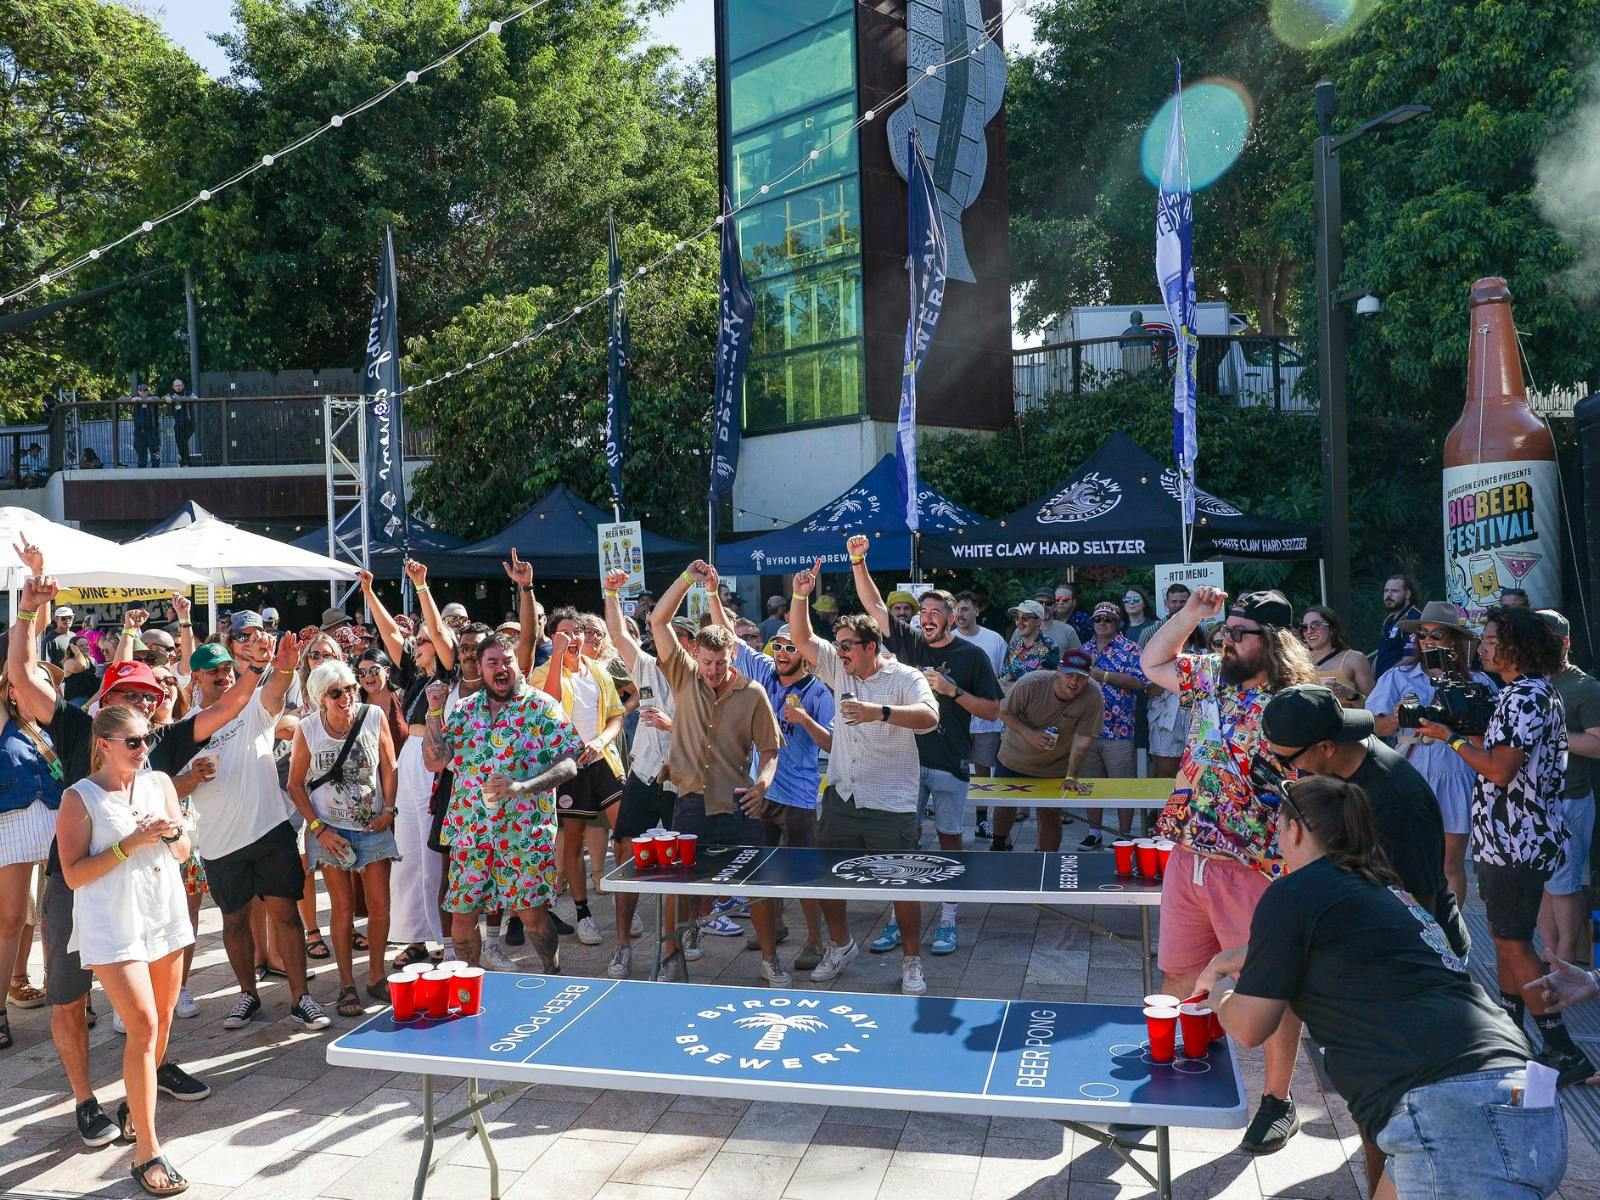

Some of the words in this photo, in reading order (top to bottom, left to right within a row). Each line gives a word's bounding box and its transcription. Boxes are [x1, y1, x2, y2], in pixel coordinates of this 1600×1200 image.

[1498, 467, 1532, 482] PRESENTS
[1448, 494, 1475, 529] BIG
[1475, 481, 1533, 520] BEER
[1447, 510, 1536, 554] FESTIVAL
[766, 556, 797, 566] BYRON
[799, 555, 817, 565] BAY
[820, 552, 867, 563] BREW
[951, 543, 993, 558] WHITE
[996, 541, 1036, 557] CLAW
[1039, 540, 1080, 555] HARD
[1083, 539, 1147, 555] SELTZER
[1185, 567, 1208, 580] MENU
[78, 587, 109, 600] WINE
[1060, 855, 1078, 872] PONG
[1059, 873, 1078, 889] BEER
[536, 984, 591, 1014] BEER
[696, 998, 821, 1020] BYRON
[828, 1004, 879, 1030] BAY
[489, 1016, 553, 1052] PONG
[1025, 1009, 1057, 1049] PONG
[675, 1034, 862, 1070] BREWERY
[1015, 1050, 1050, 1088] BEER
